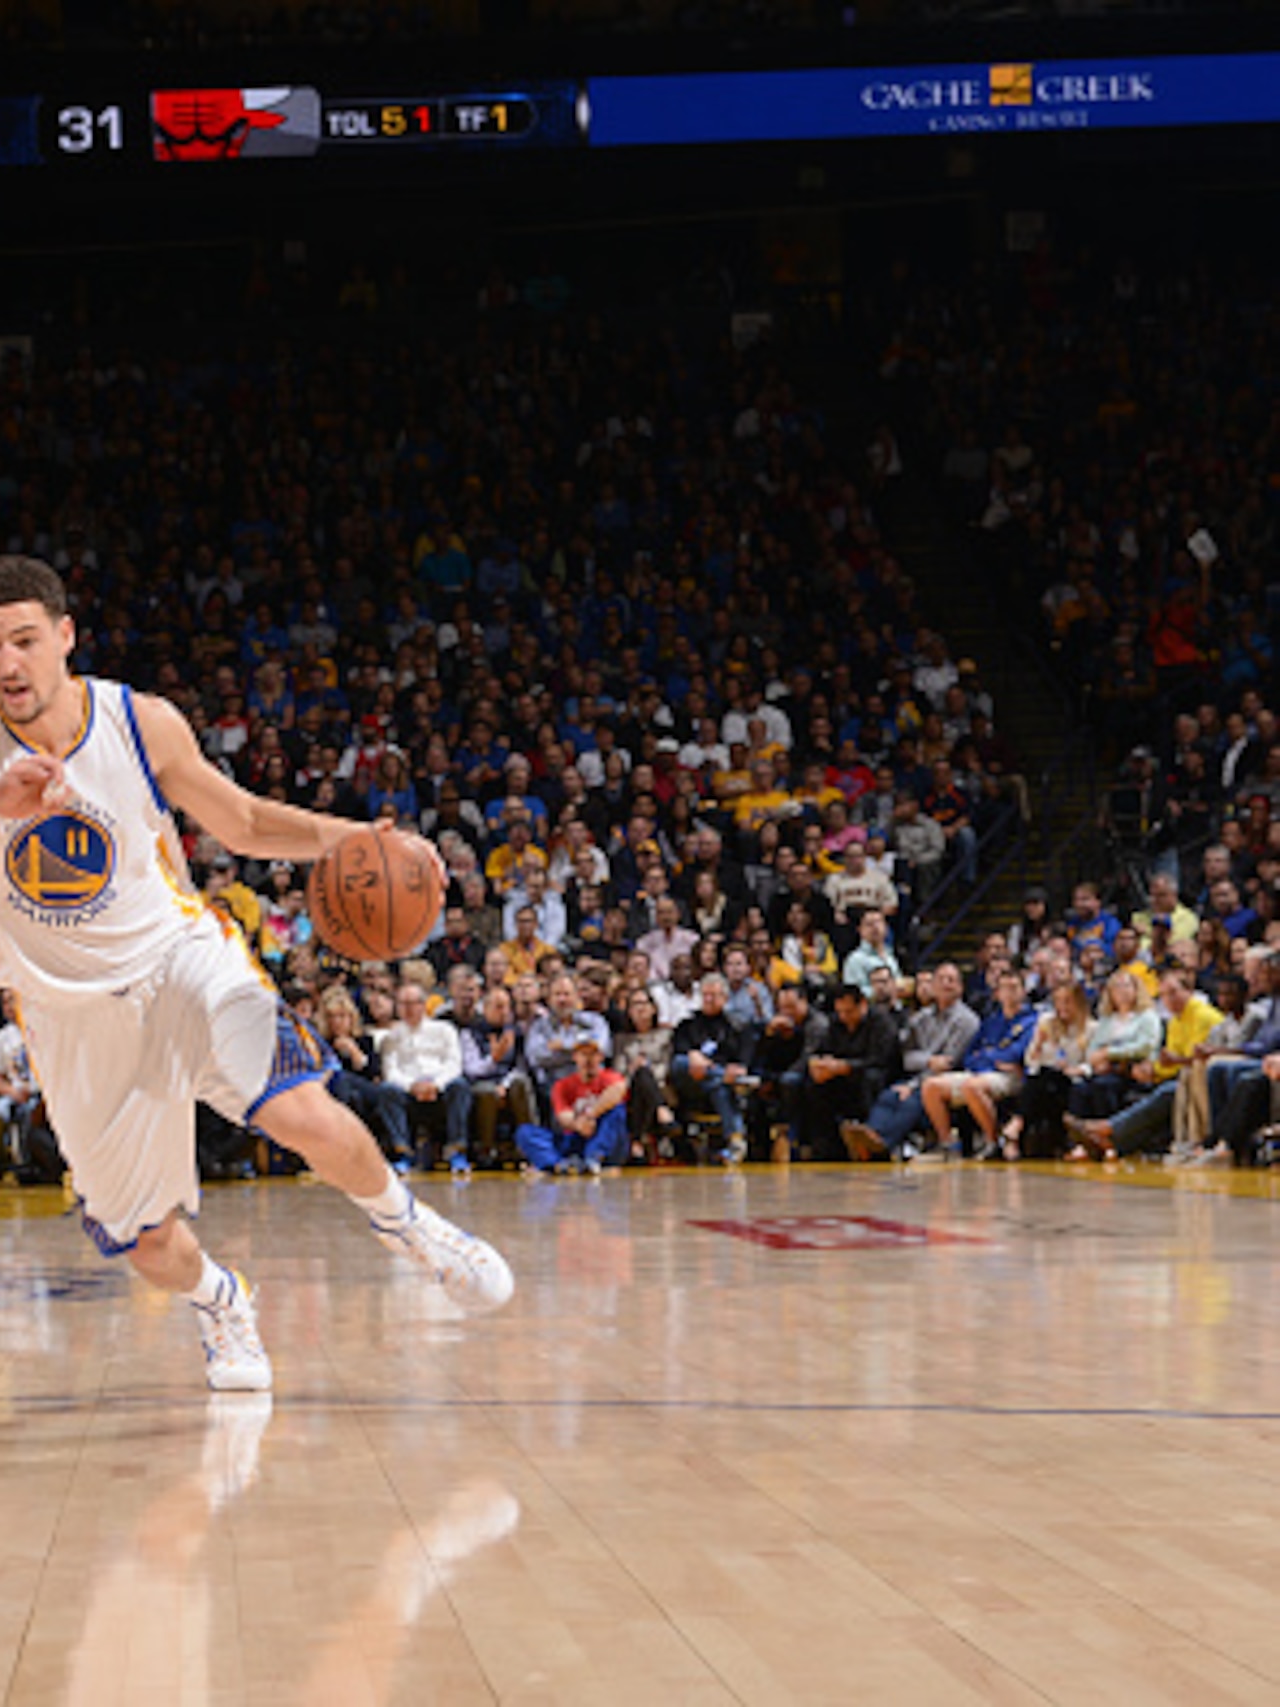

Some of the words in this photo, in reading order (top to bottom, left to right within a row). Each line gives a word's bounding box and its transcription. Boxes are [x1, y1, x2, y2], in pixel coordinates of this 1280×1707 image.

[860, 79, 981, 110] CACHE
[1036, 73, 1155, 103] CREEK
[57, 106, 122, 152] 31
[327, 111, 376, 137] TOL
[455, 108, 487, 132] TF
[66, 828, 89, 856] 11
